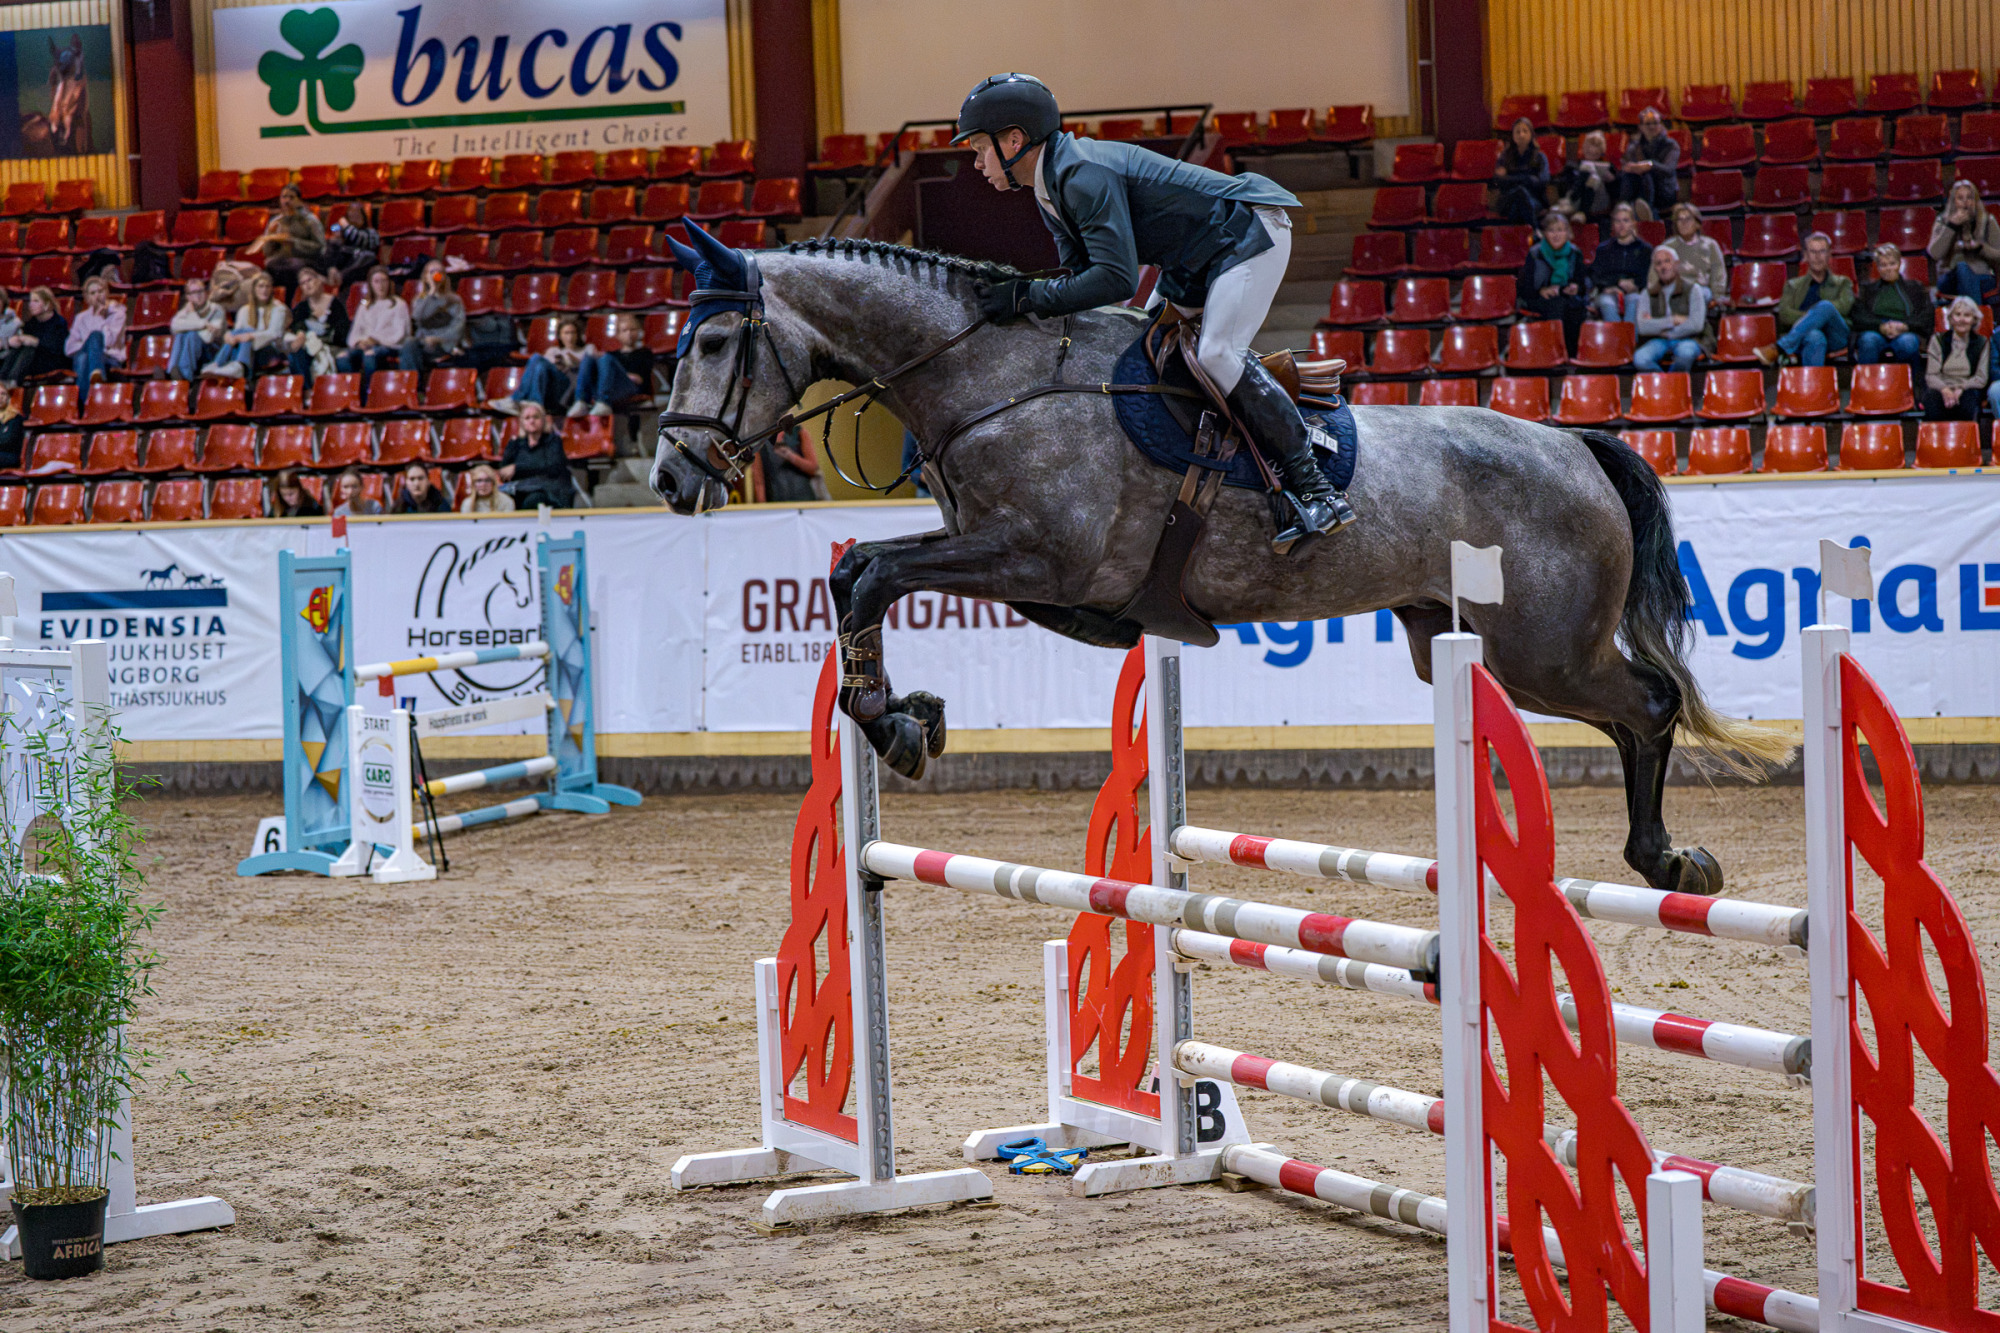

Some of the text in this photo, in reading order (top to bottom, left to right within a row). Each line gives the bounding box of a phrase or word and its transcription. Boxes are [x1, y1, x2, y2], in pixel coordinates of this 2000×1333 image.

[391, 4, 683, 107] bucas
[393, 121, 689, 157] The Intelligent Choice
[1675, 535, 1944, 660] Agria
[40, 616, 227, 640] EVIDENSIA
[110, 689, 227, 708] THÄSTSJUKHUS
[363, 717, 390, 732] START
[365, 767, 392, 784] CARO
[264, 826, 280, 854] 6
[1195, 1080, 1227, 1144] B
[53, 1239, 101, 1260] AFRICA
